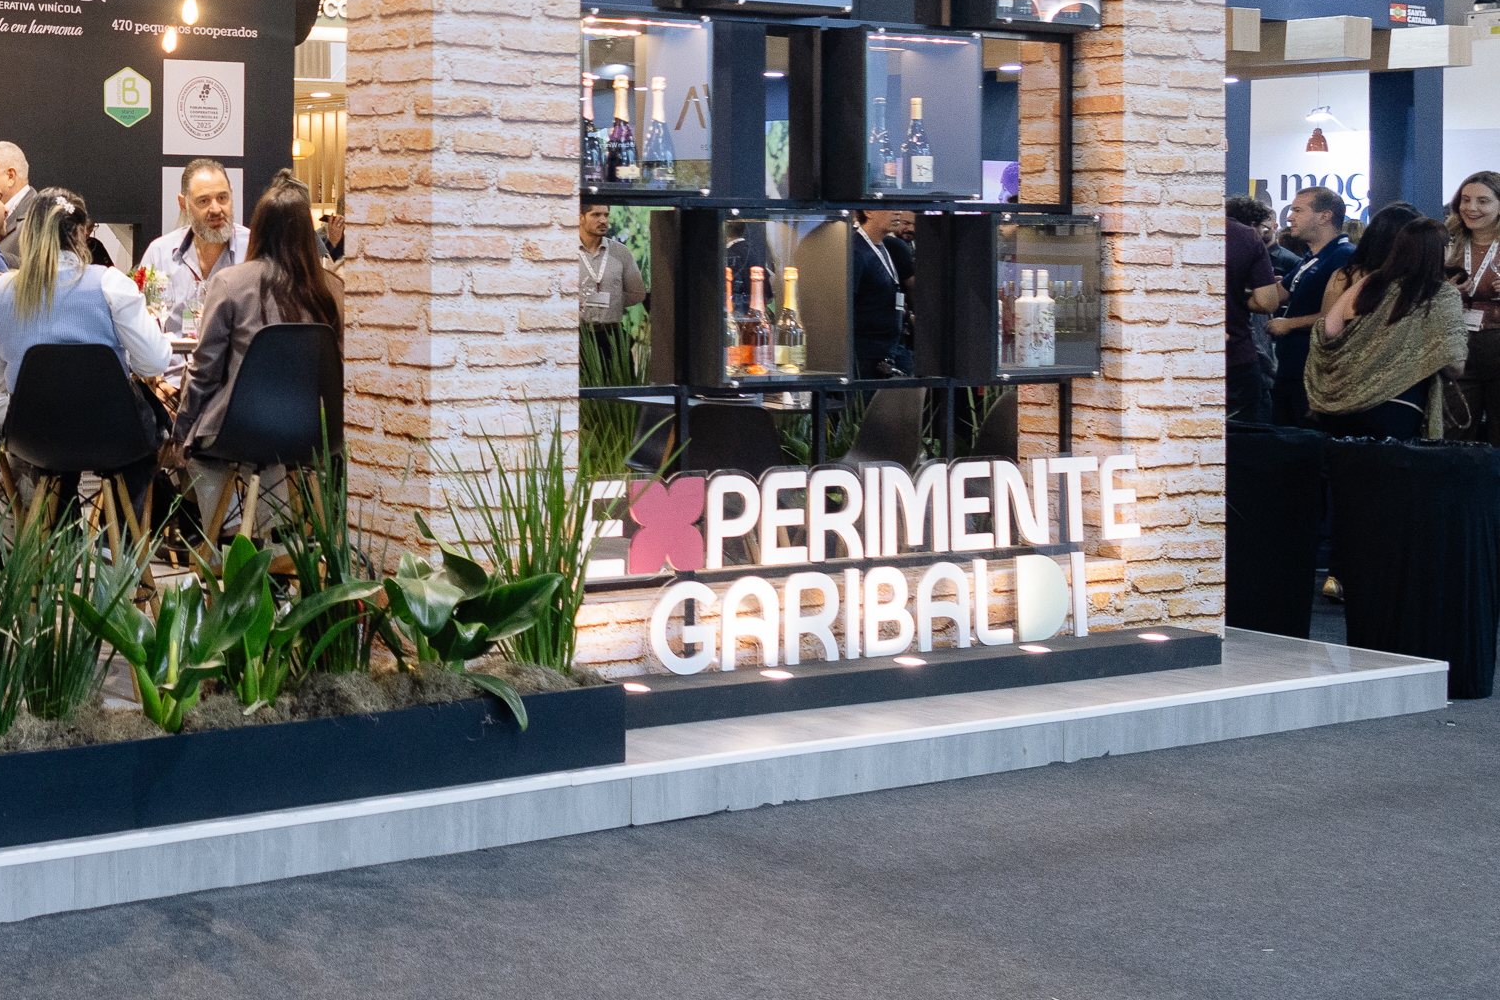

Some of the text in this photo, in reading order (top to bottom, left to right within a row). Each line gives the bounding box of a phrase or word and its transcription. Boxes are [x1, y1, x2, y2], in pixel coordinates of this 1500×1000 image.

[38, 2, 82, 14] VINÍCOLA
[1407, 9, 1426, 17] SANTA
[10, 23, 27, 34] em
[28, 19, 83, 36] harmonia
[112, 19, 133, 32] 470
[193, 25, 258, 39] cooperados
[1407, 16, 1437, 25] CATARINA
[580, 454, 1141, 578] EXPERIMENTE
[650, 552, 1089, 675] GARIBALDI
